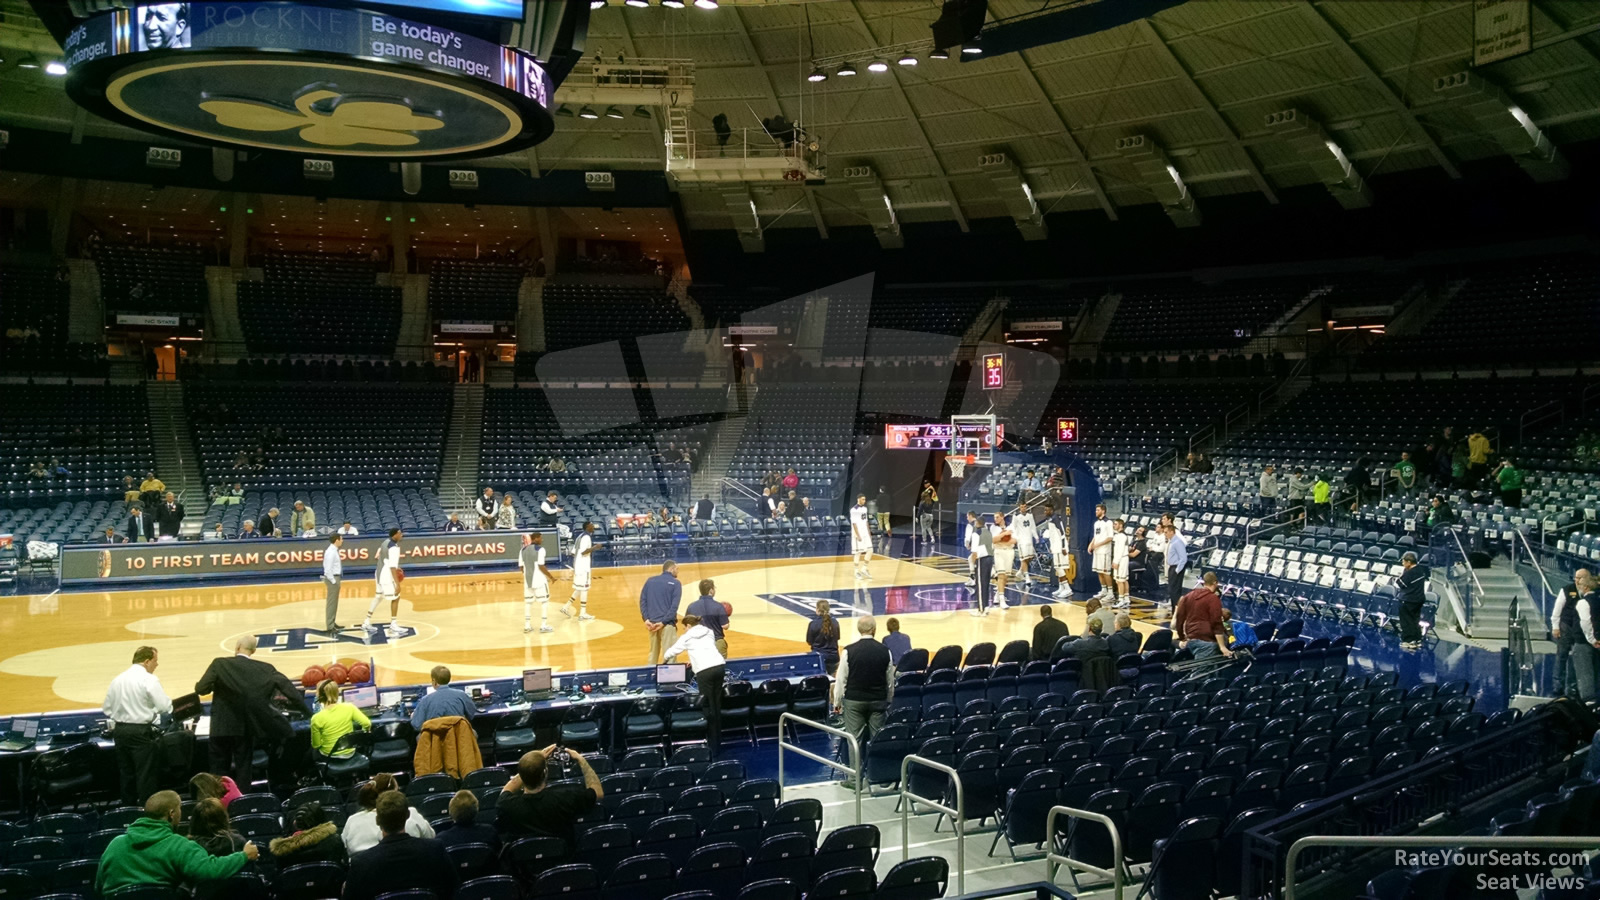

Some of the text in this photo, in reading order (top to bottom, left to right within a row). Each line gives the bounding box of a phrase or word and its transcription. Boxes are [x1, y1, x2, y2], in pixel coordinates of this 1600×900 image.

[204, 5, 343, 34] ROCKNE
[372, 16, 462, 49] Be today's
[371, 40, 492, 78] game changer.
[988, 367, 1001, 385] 35
[1062, 429, 1073, 439] 35
[125, 556, 146, 570] 10
[152, 554, 204, 568] FIRST
[210, 552, 259, 567] TEAM
[264, 548, 369, 564] CONSESUS
